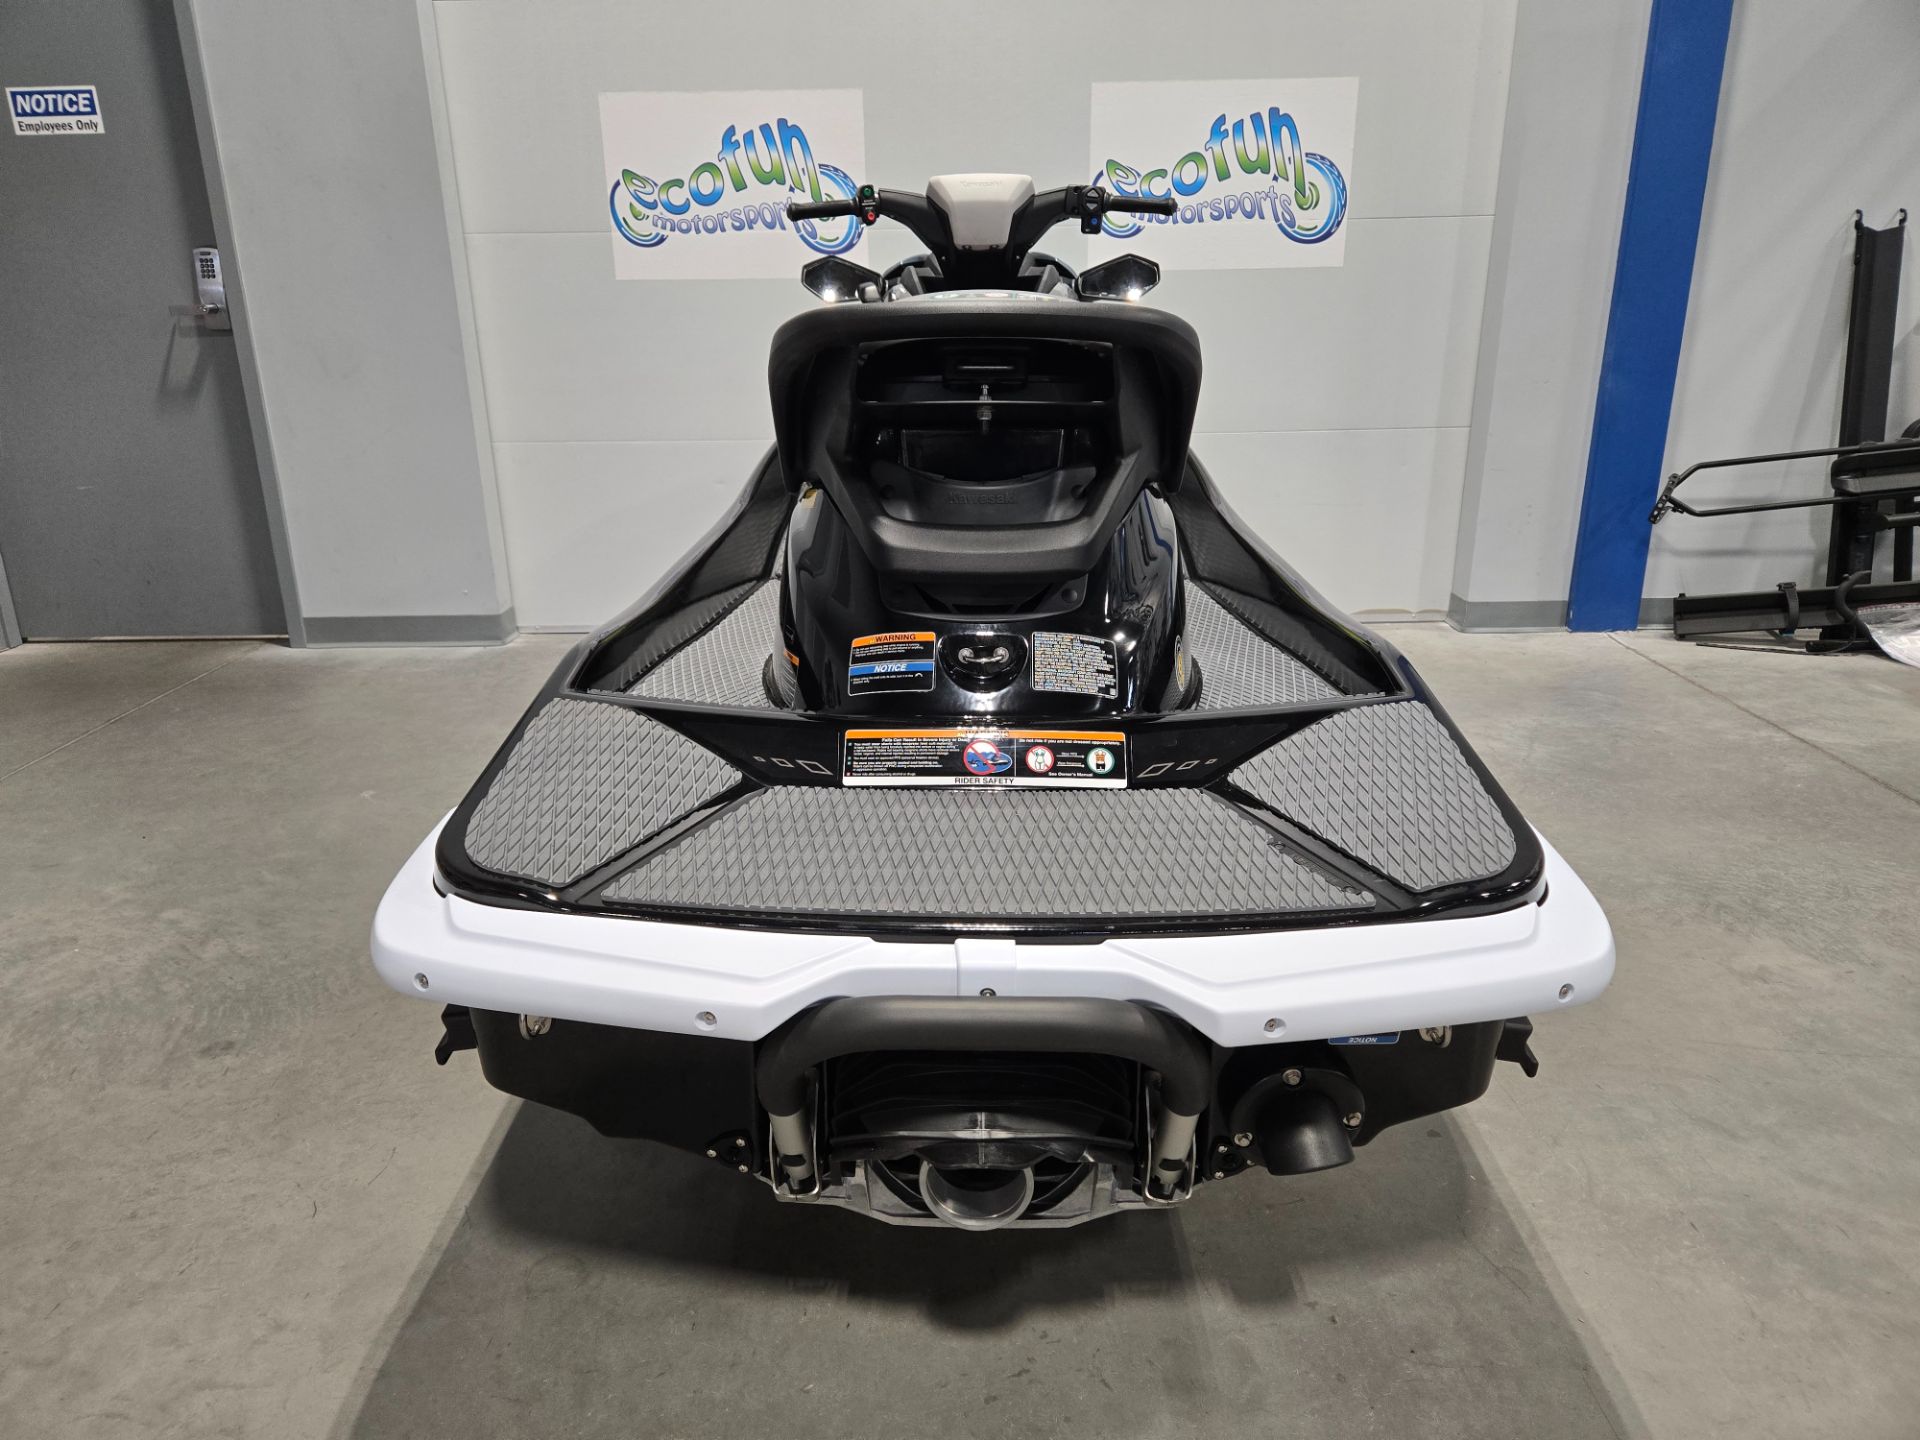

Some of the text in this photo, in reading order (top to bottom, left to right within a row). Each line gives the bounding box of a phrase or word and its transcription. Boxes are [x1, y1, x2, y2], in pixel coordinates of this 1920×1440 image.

[15, 93, 92, 114] NOTICE
[18, 119, 99, 133] Employees Only
[1106, 107, 1306, 199] ecofun
[621, 117, 823, 216] ecofun
[875, 633, 916, 642] WARNING
[874, 663, 907, 673] NOTICE
